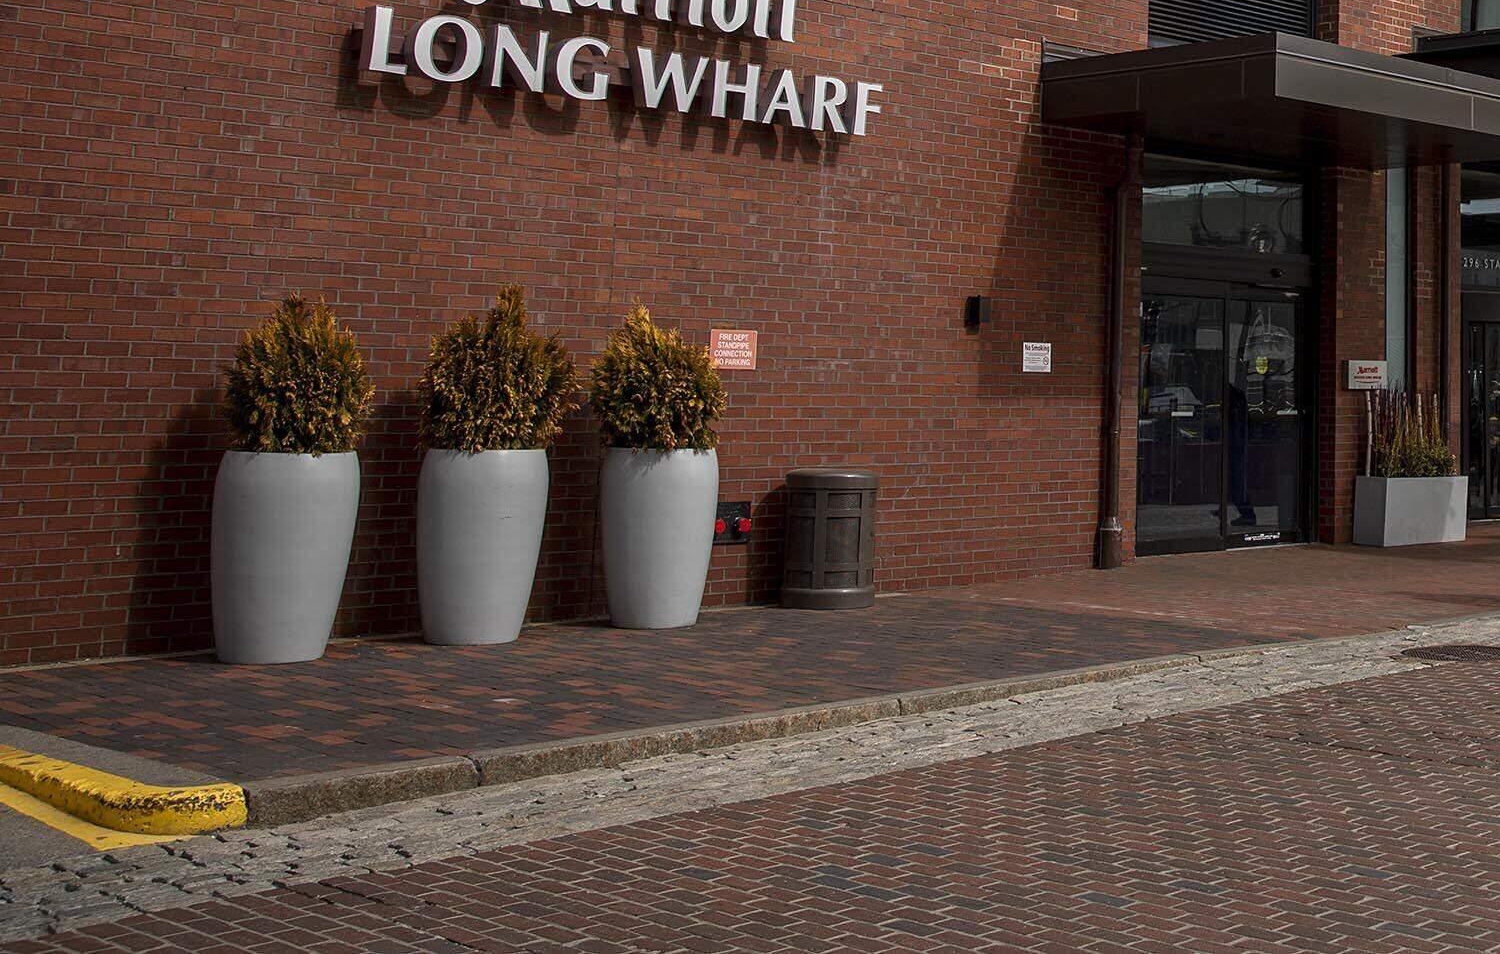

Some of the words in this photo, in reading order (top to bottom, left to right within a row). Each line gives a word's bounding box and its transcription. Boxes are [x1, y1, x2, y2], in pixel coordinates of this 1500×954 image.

[366, 5, 611, 101] LONG
[635, 46, 883, 136] WHARF
[1463, 257, 1479, 268] 296
[719, 333, 733, 341] FIRE
[733, 333, 749, 341] DEPT
[717, 341, 750, 349] STANDPIPE
[1024, 343, 1031, 351] No
[1031, 343, 1050, 353] Smoking
[714, 349, 752, 357] CONNECTION
[724, 357, 751, 366] PARKING
